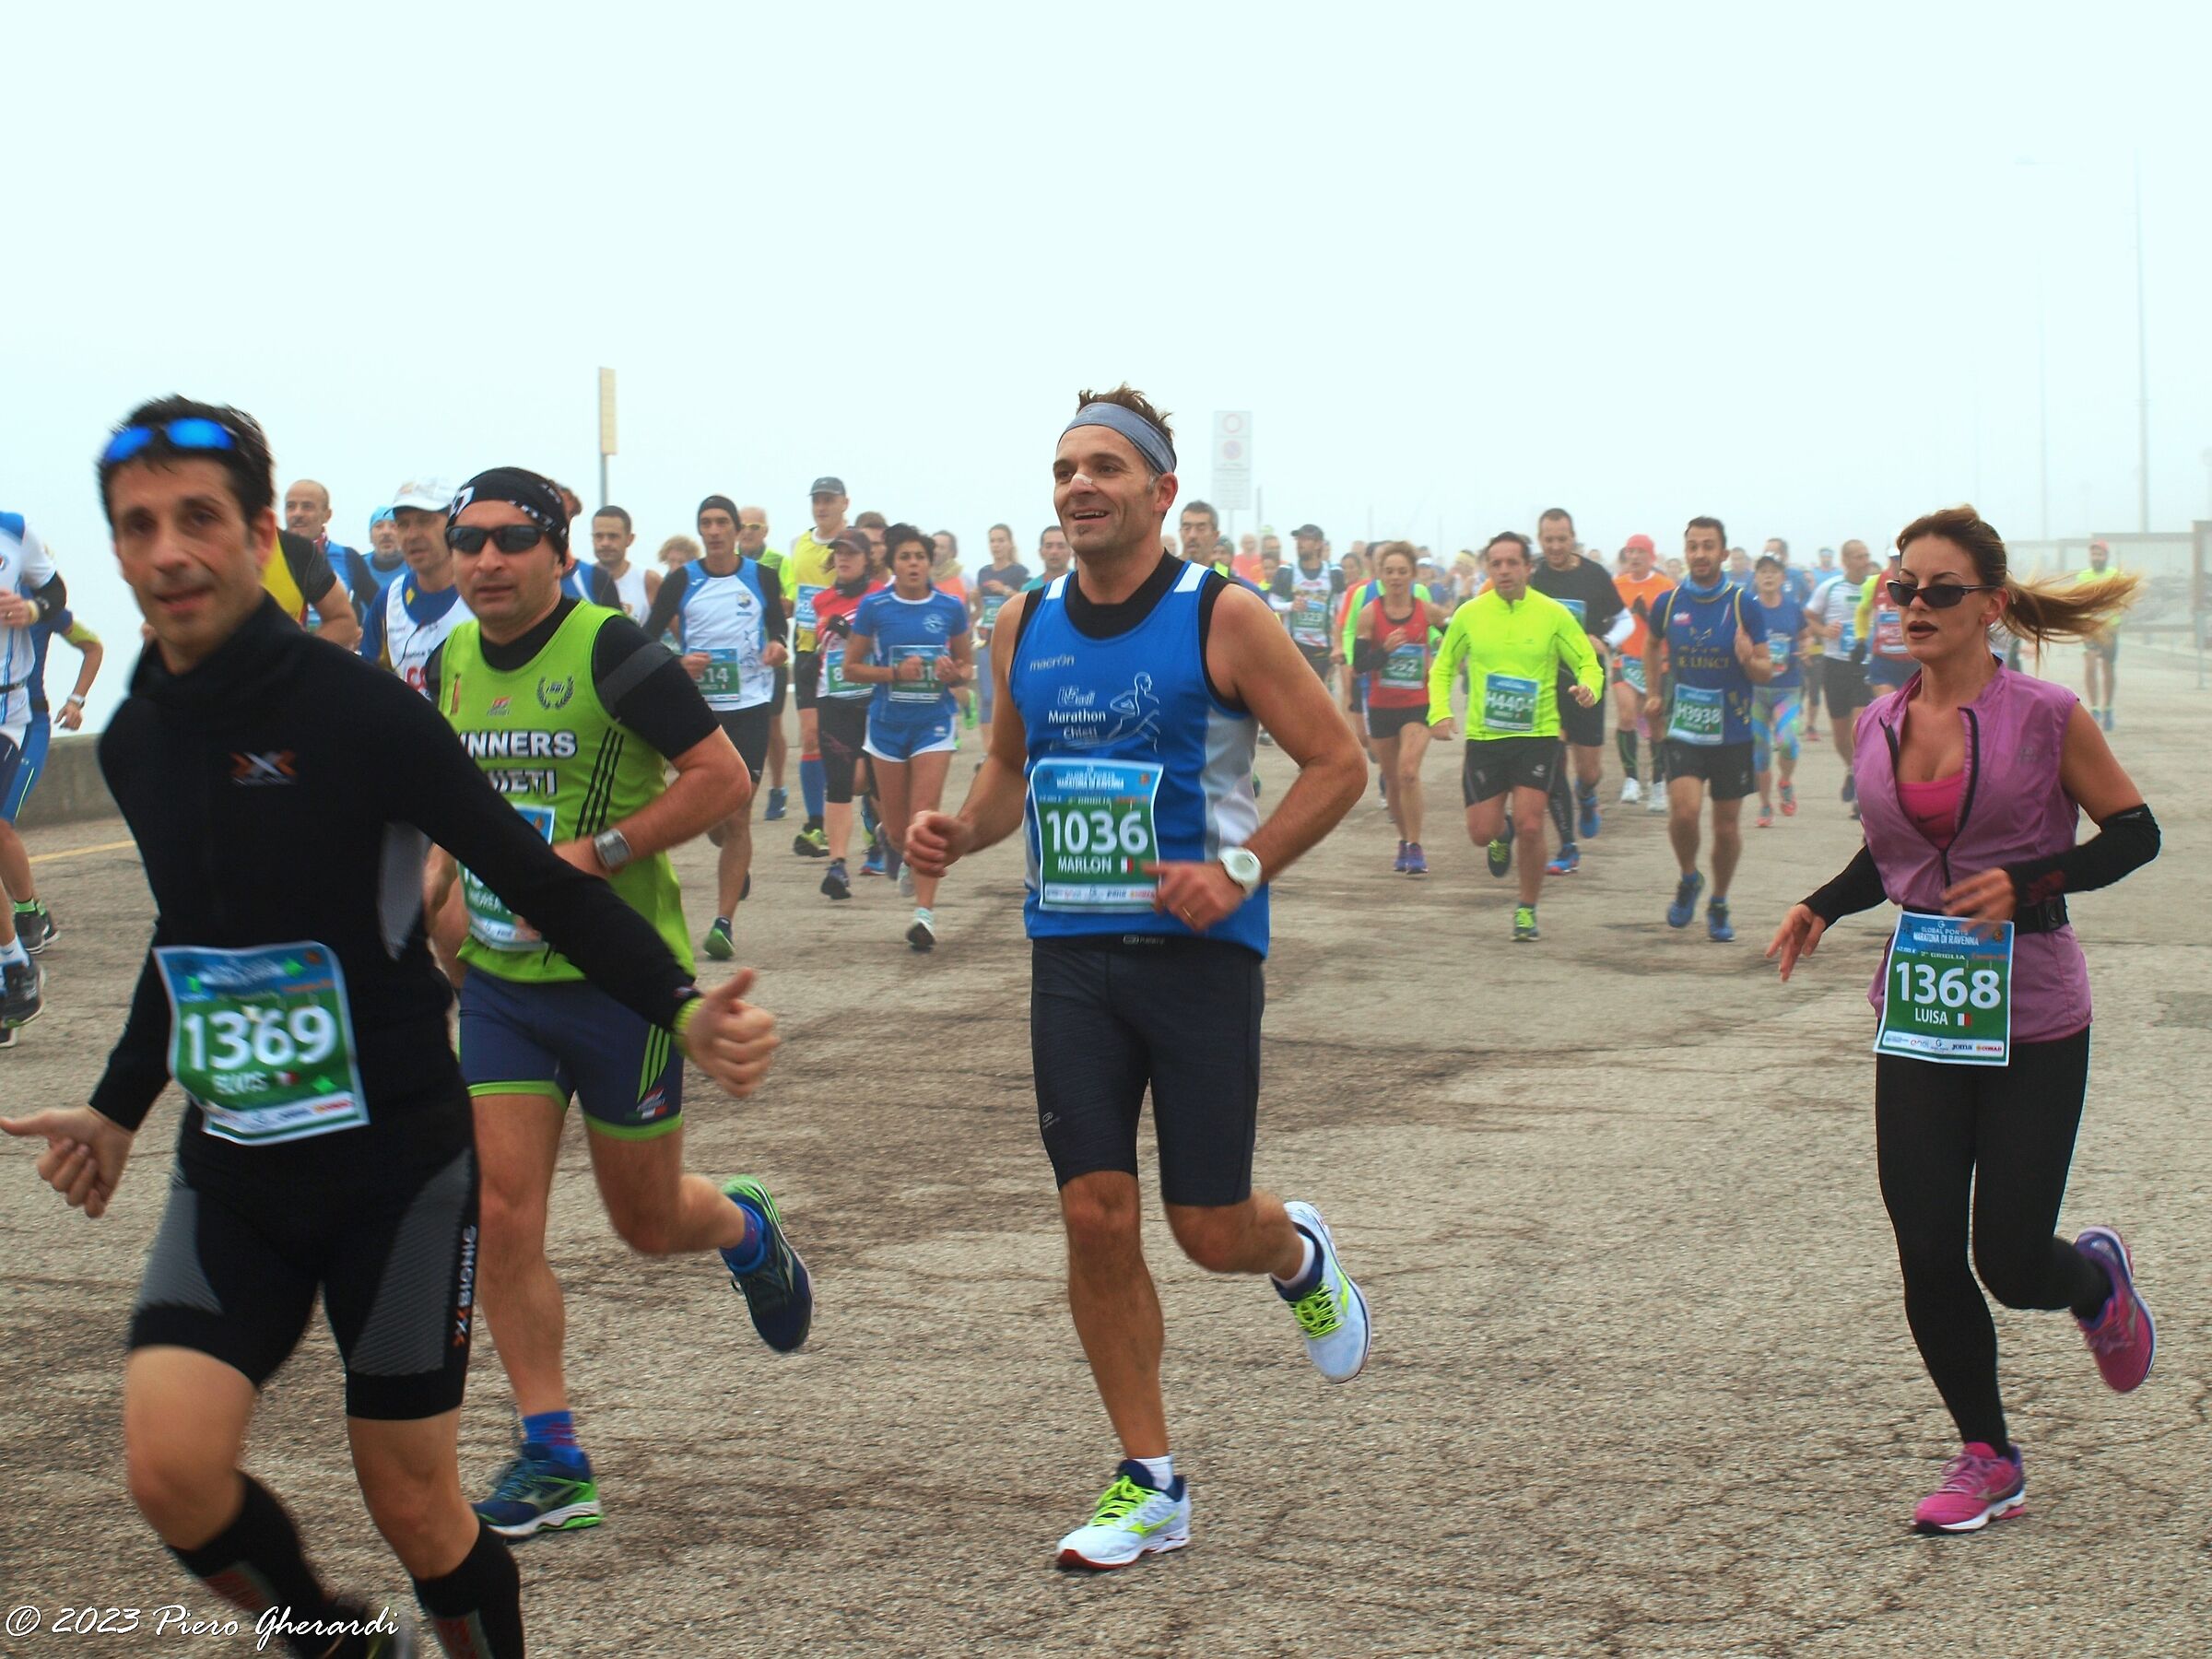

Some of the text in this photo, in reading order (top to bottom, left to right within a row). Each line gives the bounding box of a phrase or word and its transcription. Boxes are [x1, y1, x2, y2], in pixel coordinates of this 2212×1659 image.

[695, 666, 729, 683] 14
[1048, 709, 1106, 724] Marathon
[1046, 809, 1148, 855] 1036
[1057, 855, 1112, 875] MARLON
[1912, 931, 1980, 947] MARATONA DI RAVENNA
[1921, 926, 1943, 935] GLOBAL
[1896, 961, 2001, 1009] 1368
[1914, 1007, 1948, 1026] LUISA
[184, 1005, 337, 1072] 1369
